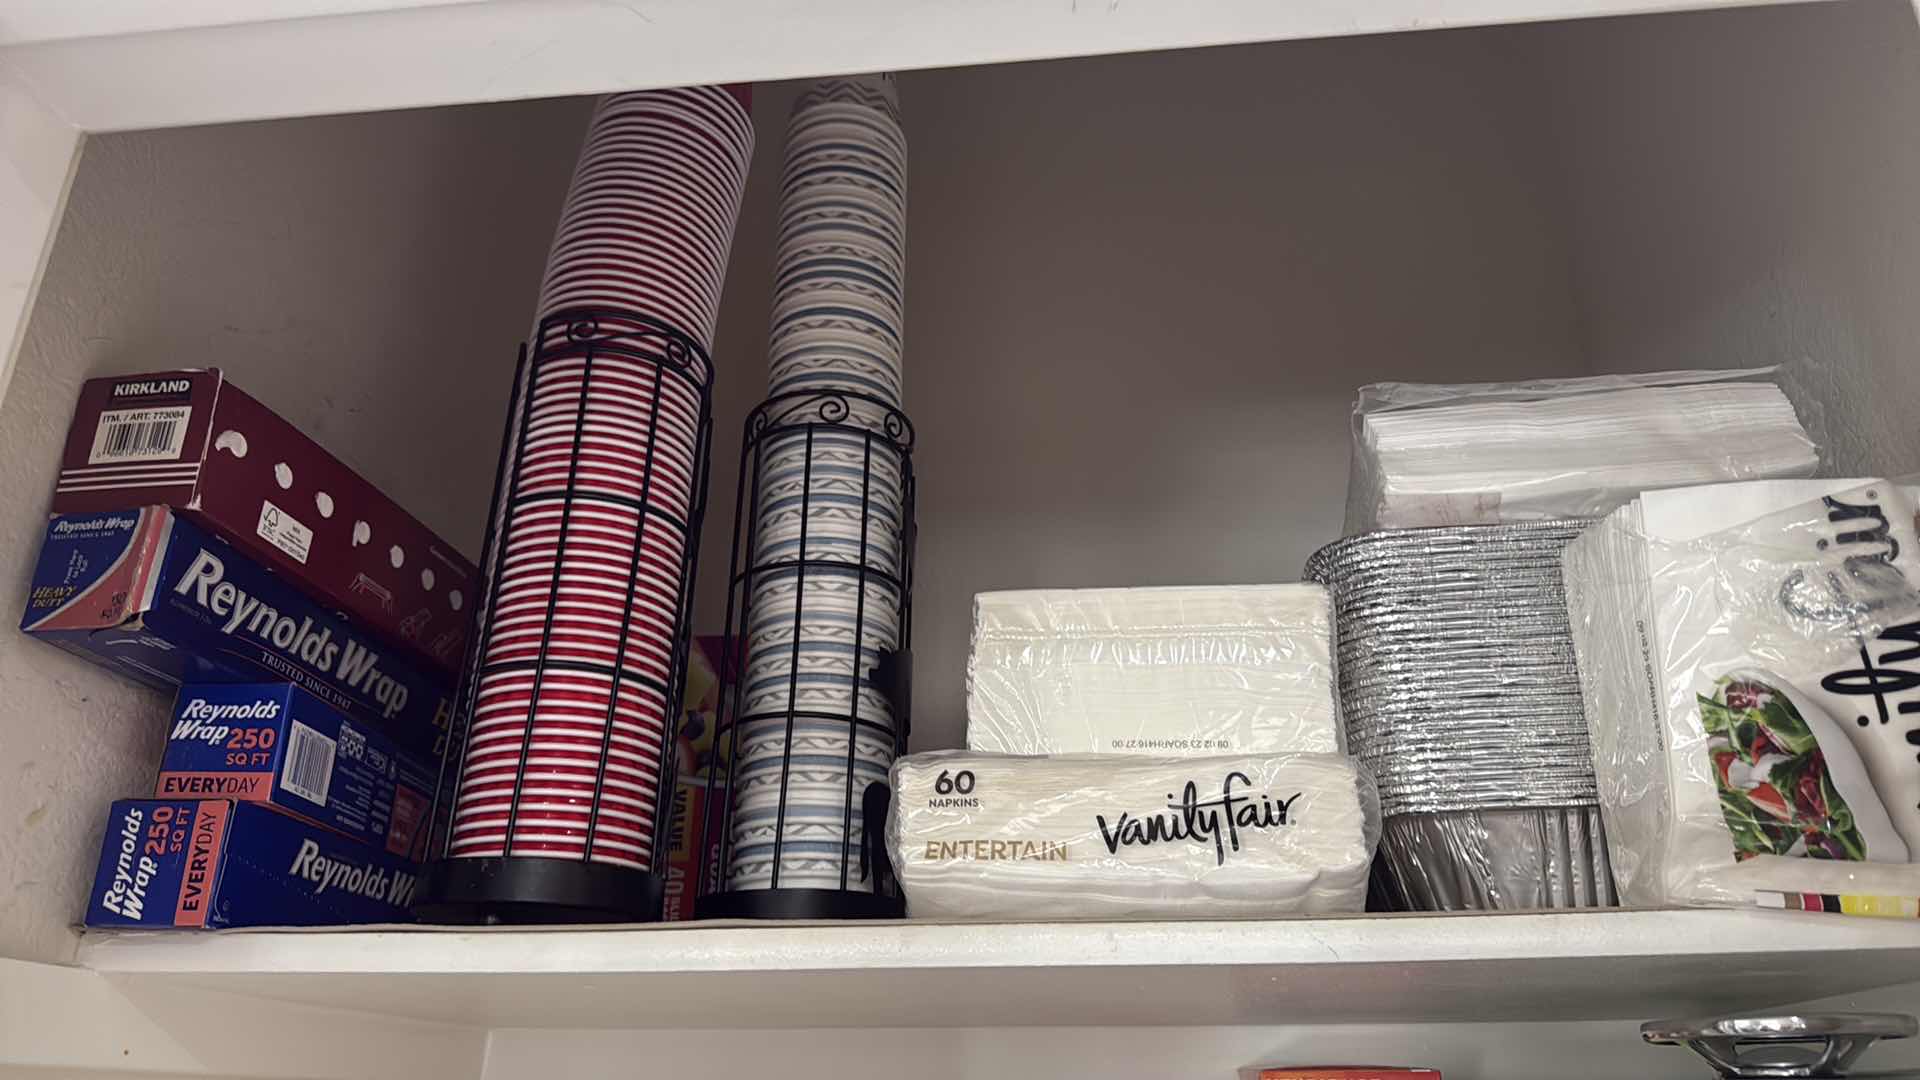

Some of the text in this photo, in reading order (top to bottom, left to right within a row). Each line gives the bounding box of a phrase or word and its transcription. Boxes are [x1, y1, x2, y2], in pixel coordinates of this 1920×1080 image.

[114, 380, 190, 396] KIRKLAND
[174, 547, 409, 718] Reynolds Wrap
[262, 651, 304, 682] TRUSTED
[304, 675, 332, 699] SINCE
[182, 698, 280, 724] Reynolds
[170, 720, 276, 749] Wrap 250
[226, 752, 270, 766] SQ FT
[164, 777, 260, 793] EVERYDAY
[934, 769, 976, 795] 60
[928, 798, 979, 808] NAPKINS
[170, 807, 191, 853] SQ FT
[102, 807, 143, 914] Reynolds
[121, 806, 174, 920] Wrap 250
[182, 811, 217, 912] EVERYDAY
[924, 840, 1068, 861] ENTERTAIN
[288, 838, 389, 900] Reynolds
